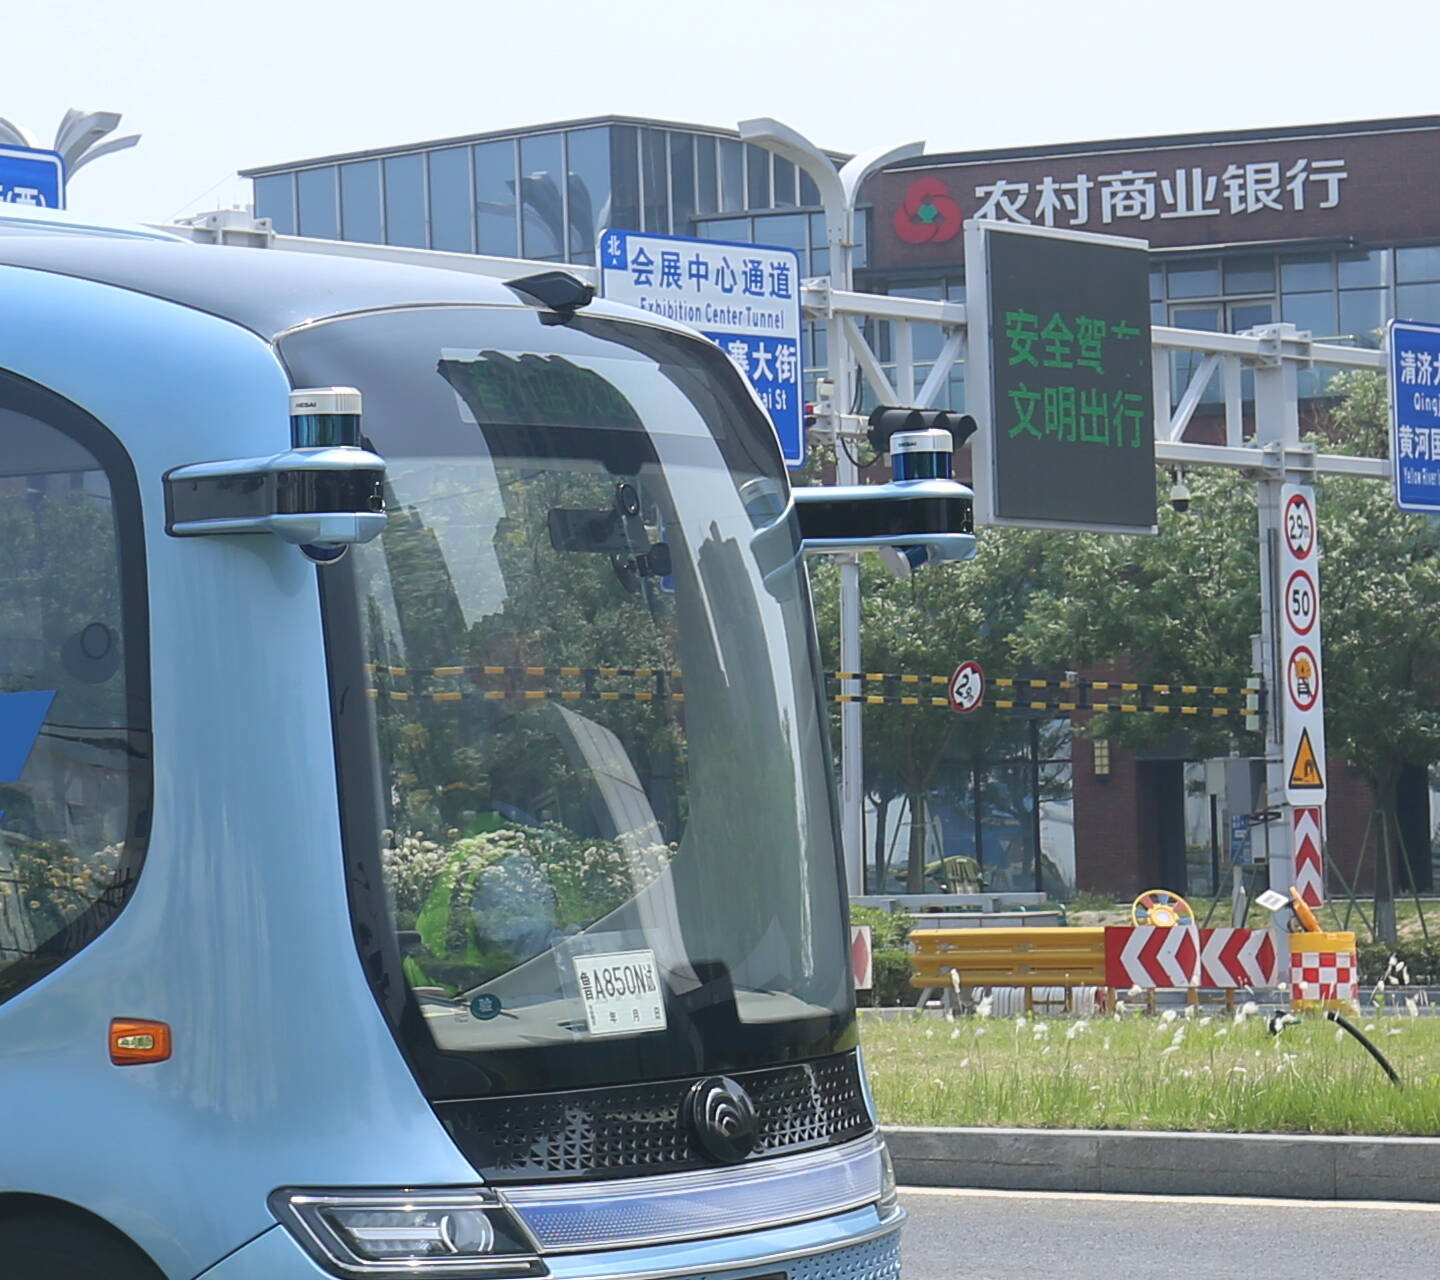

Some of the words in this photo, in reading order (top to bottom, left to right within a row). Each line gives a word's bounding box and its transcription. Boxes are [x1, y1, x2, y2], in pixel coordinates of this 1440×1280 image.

[974, 158, 1348, 227] 农村商业银行
[607, 235, 621, 256] 北
[631, 247, 792, 300] 会展中心通道
[640, 297, 702, 323] Exhibition
[705, 303, 743, 327] Center
[746, 306, 785, 330] Tunnel
[775, 389, 787, 411] St
[1008, 382, 1145, 448] 文明出行
[1292, 589, 1310, 616] 50
